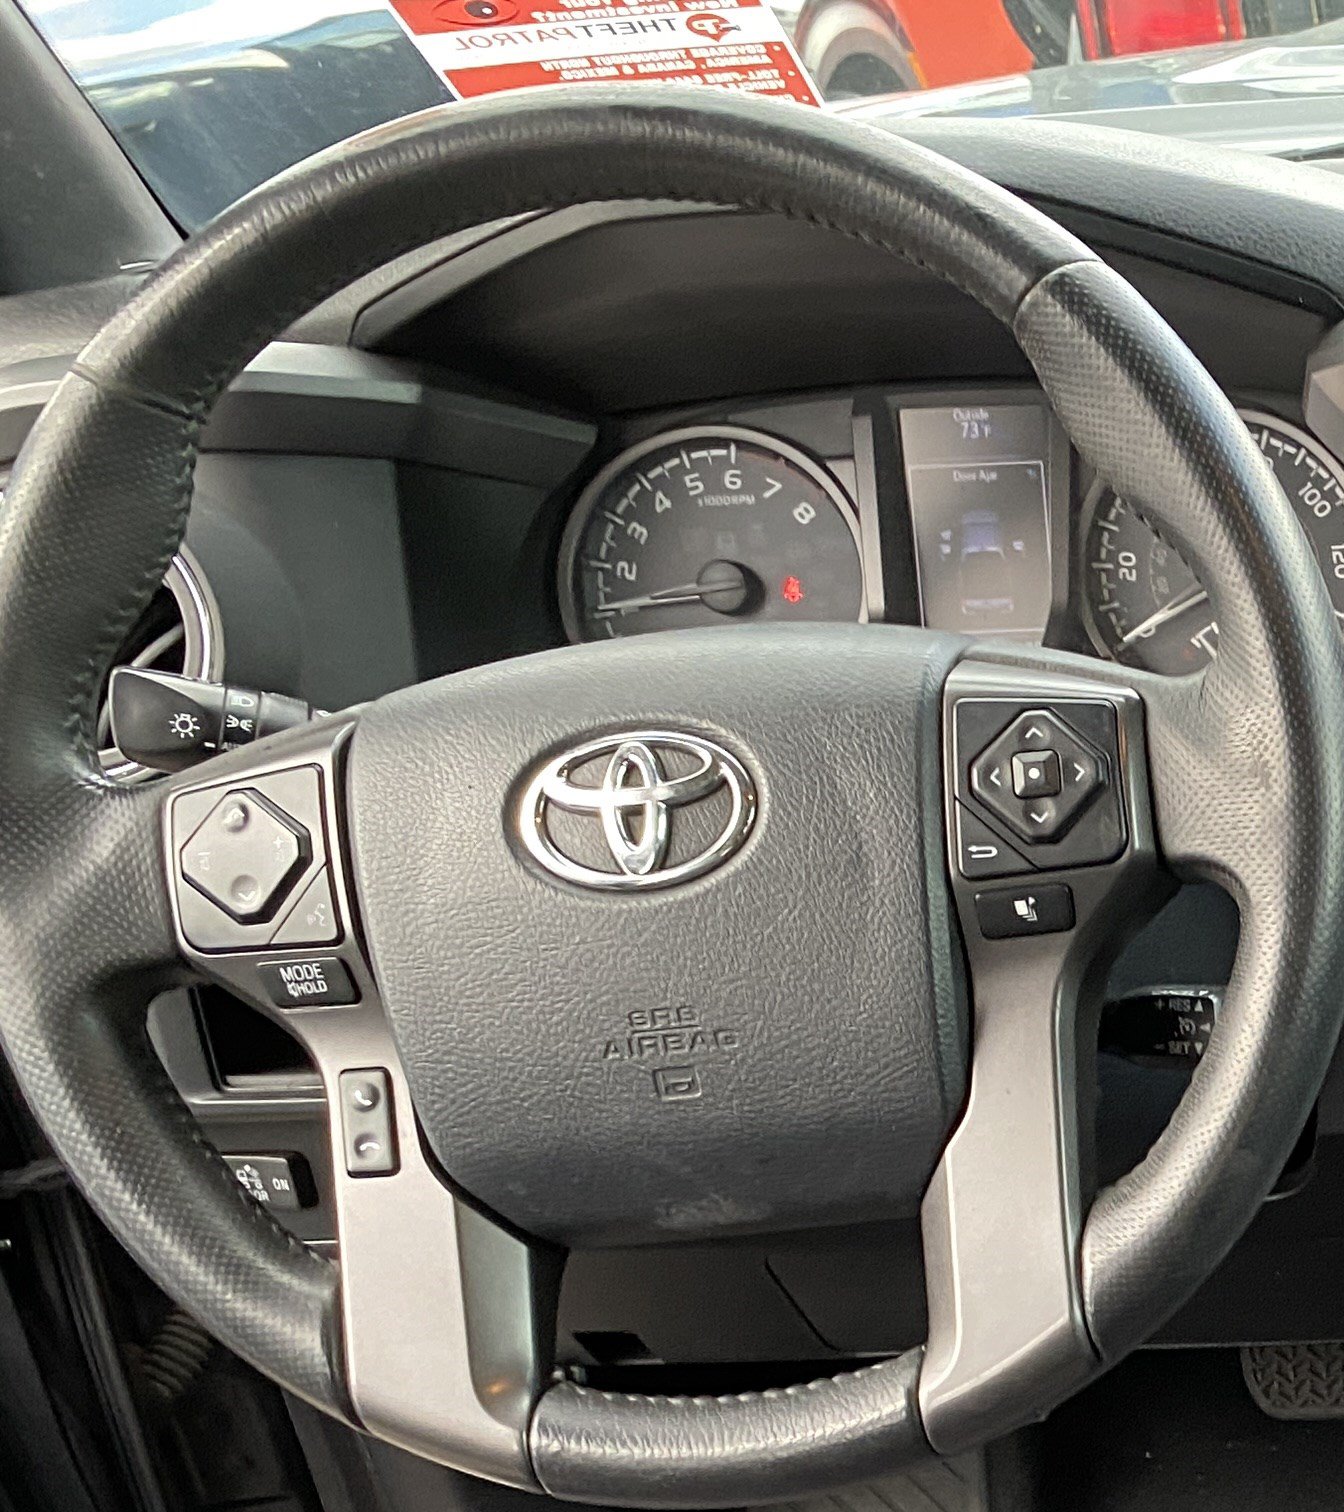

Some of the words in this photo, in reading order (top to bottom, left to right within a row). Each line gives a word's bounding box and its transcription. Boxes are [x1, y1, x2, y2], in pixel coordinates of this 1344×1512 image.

[684, 472, 705, 496] 5
[723, 469, 743, 490] 6
[762, 477, 783, 499] 7
[654, 490, 673, 514] 4
[1297, 481, 1333, 518] 100
[792, 501, 817, 525] 8
[626, 521, 649, 545] 3
[616, 560, 638, 581] 2
[1118, 551, 1137, 582] 20
[279, 962, 325, 983] MODE
[296, 980, 329, 997] HOLD
[272, 1177, 290, 1191] ON
